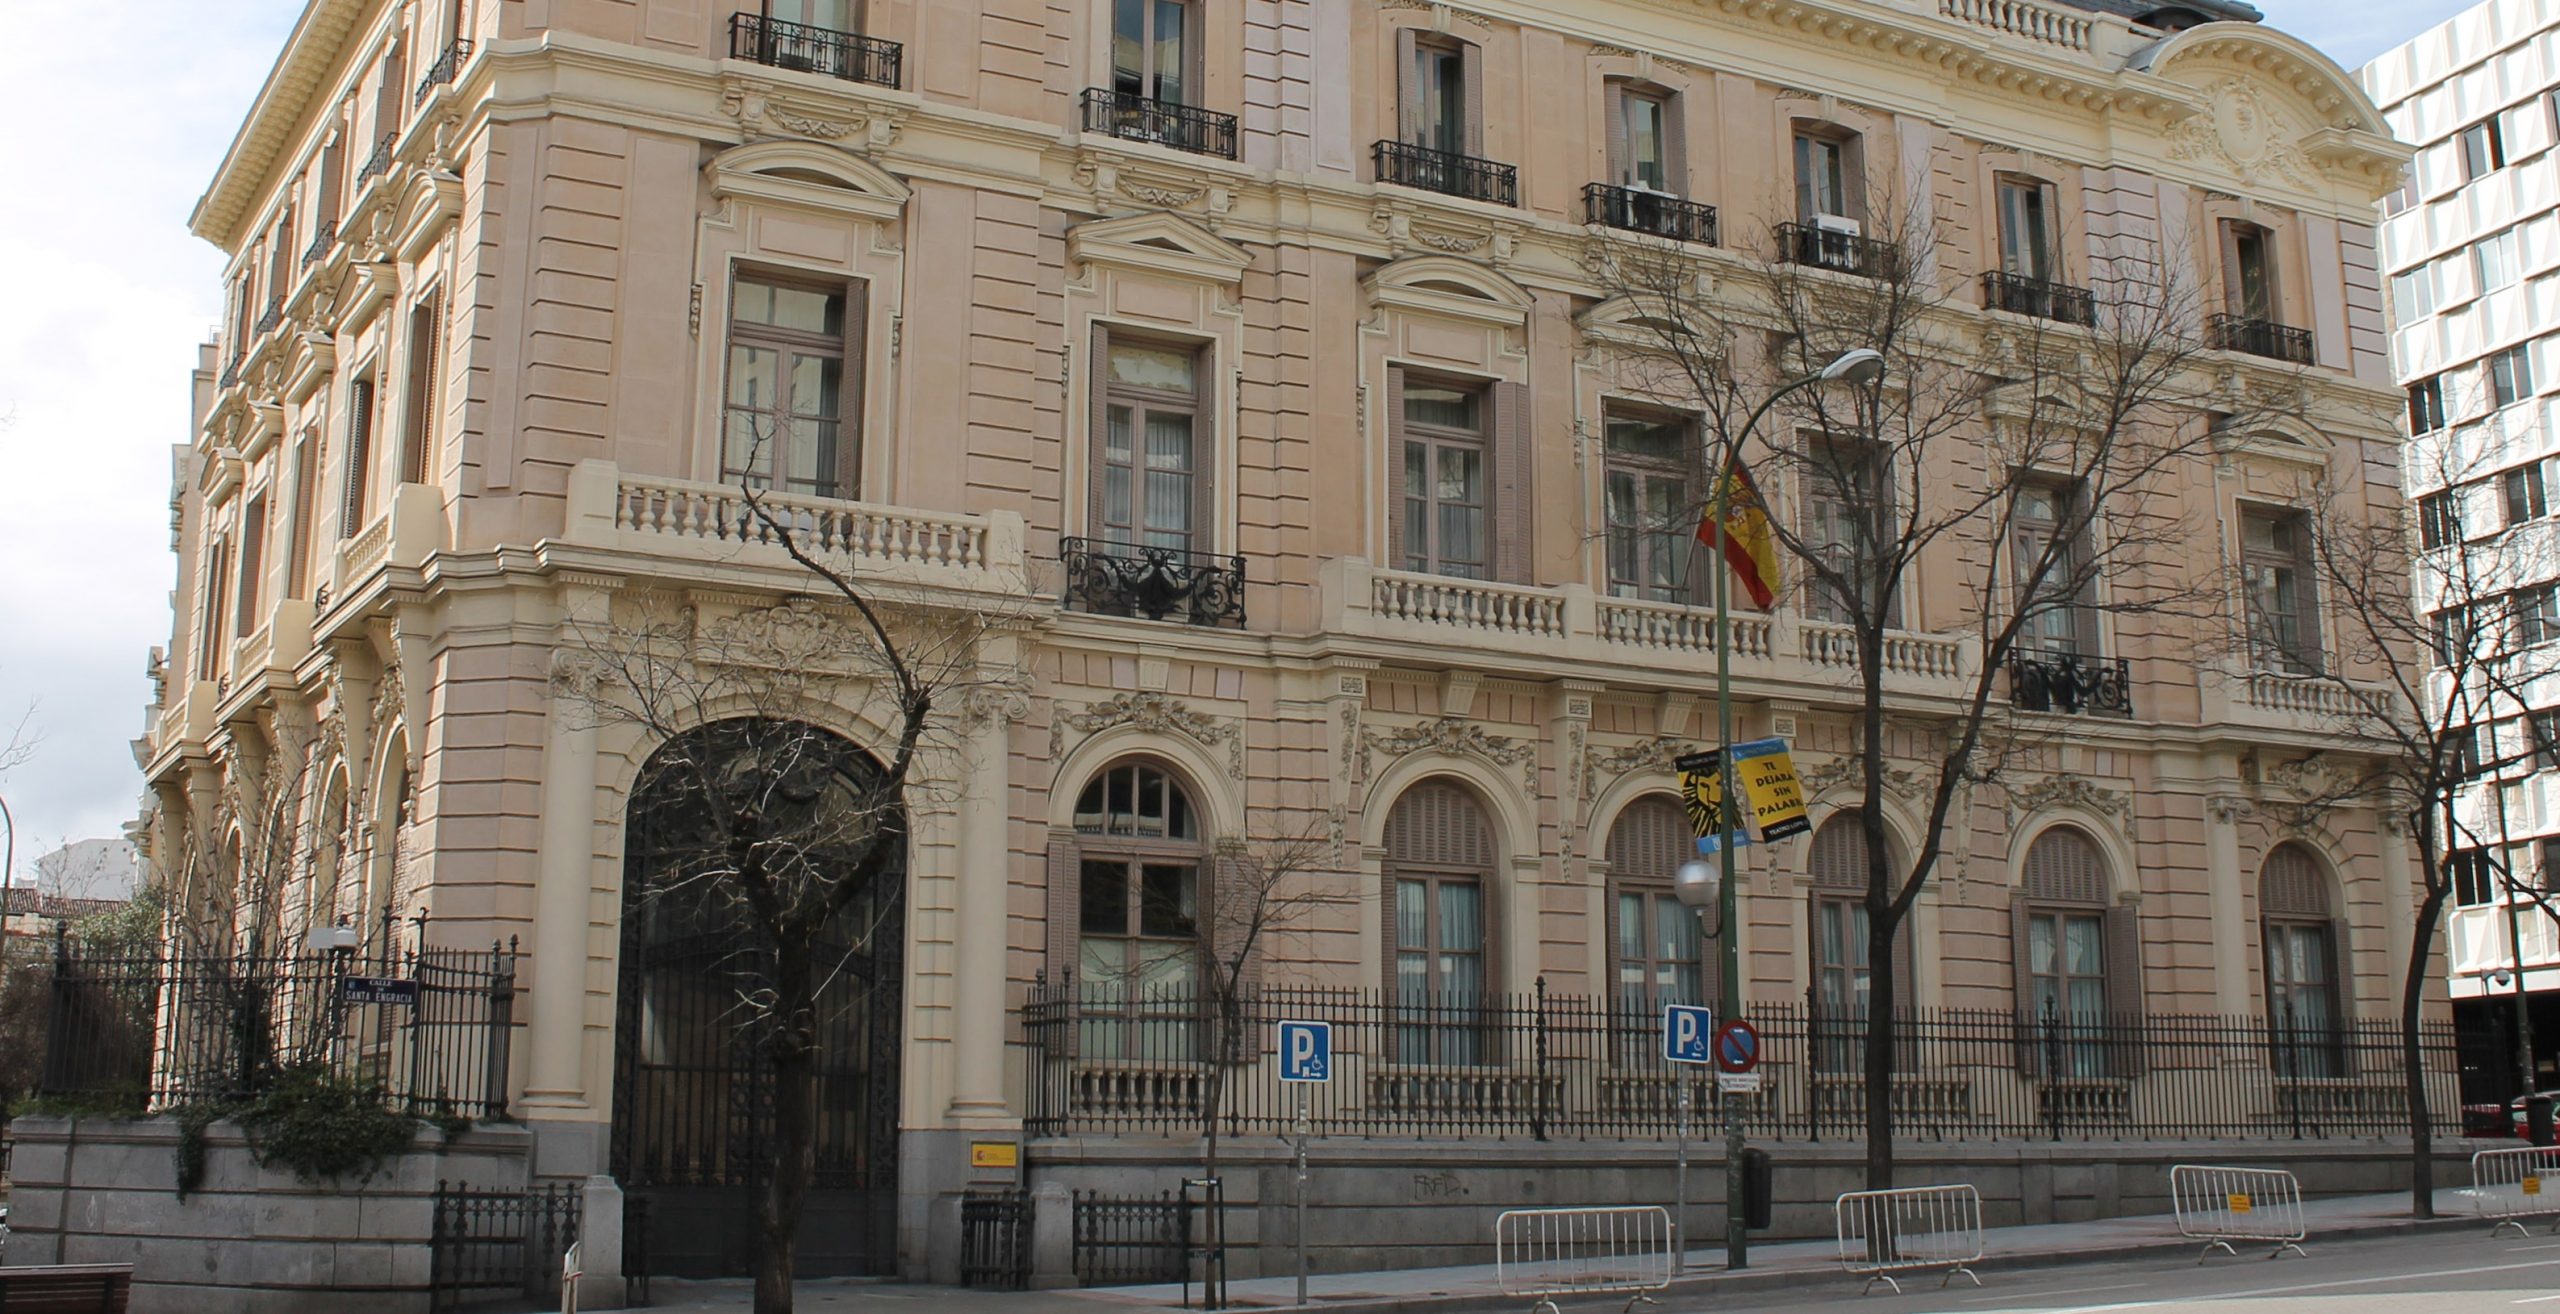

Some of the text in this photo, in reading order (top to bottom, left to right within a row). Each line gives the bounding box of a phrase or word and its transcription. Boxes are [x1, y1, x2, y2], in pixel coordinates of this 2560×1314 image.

[1762, 761, 1776, 771] TE
[1773, 786, 1792, 797] SIN
[346, 991, 413, 1003] SANTA ENGRACIA
[1677, 1011, 1697, 1054] P
[1292, 1027, 1314, 1073] P
